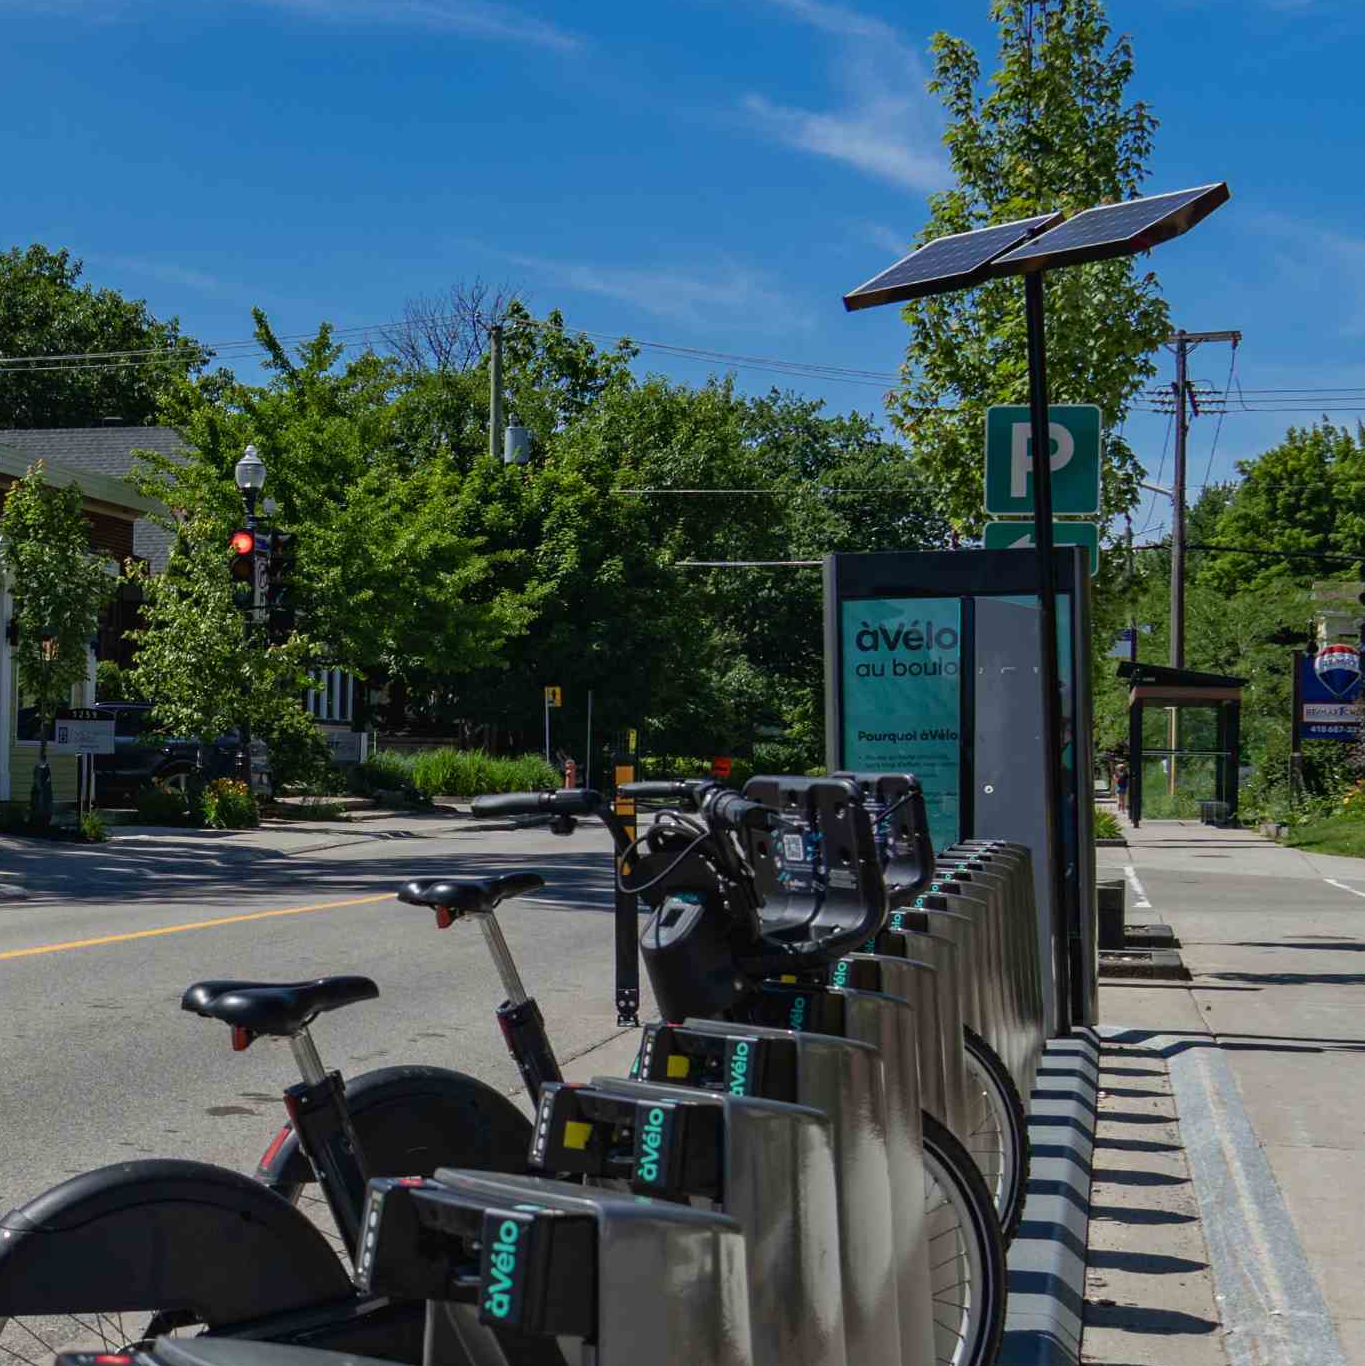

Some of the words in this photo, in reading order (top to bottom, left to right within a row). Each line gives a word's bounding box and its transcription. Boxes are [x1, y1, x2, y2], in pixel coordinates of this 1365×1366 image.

[1010, 422, 1075, 498] P
[856, 663, 885, 676] au
[858, 730, 917, 744] Pourquoi
[790, 997, 806, 1031] Vélo
